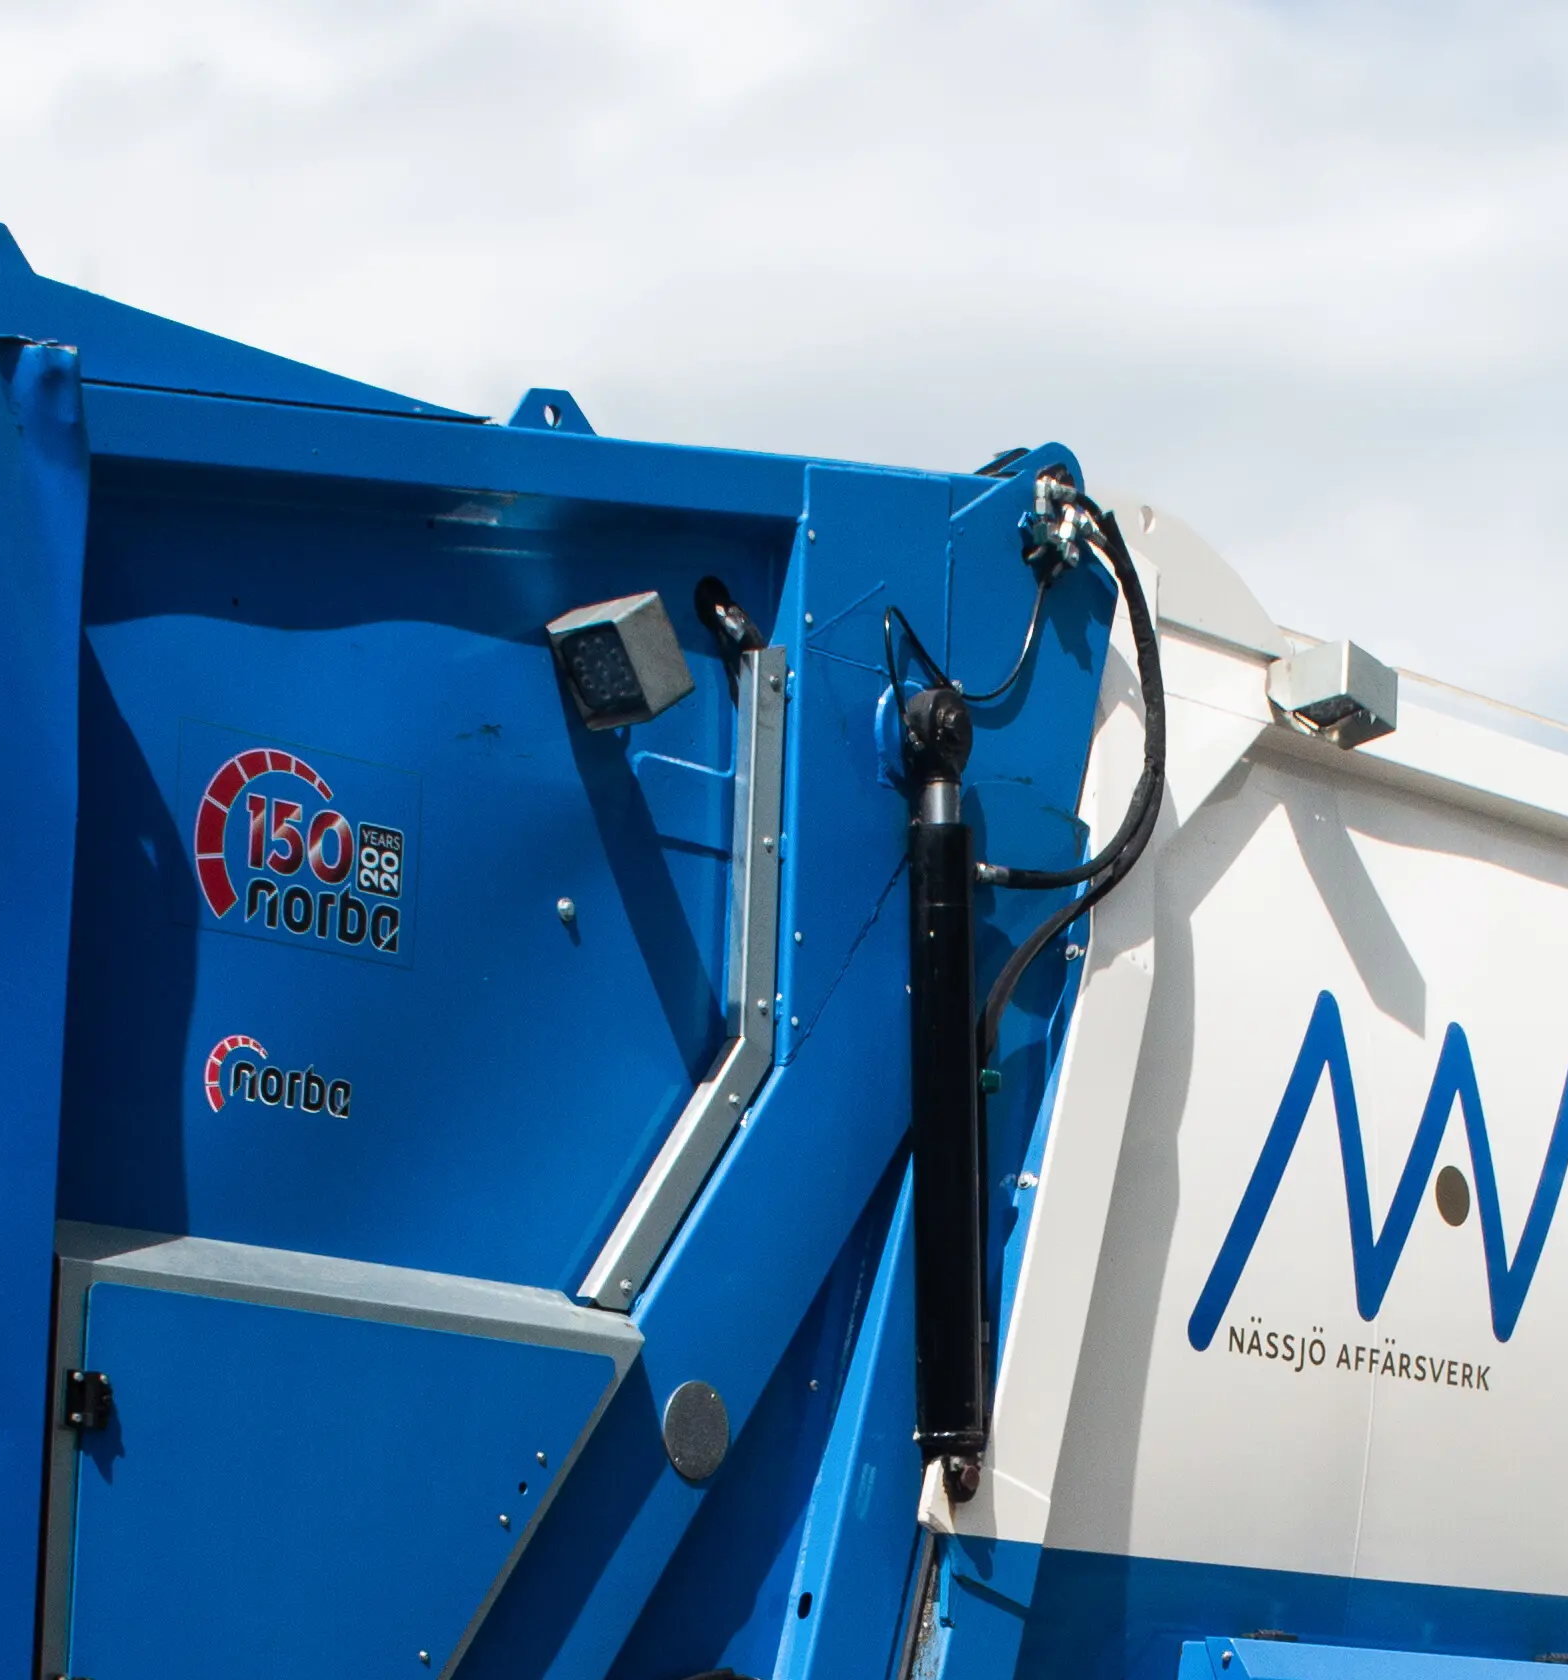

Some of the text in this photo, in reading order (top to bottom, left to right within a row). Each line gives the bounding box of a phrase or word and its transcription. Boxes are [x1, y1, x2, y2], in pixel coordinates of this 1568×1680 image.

[246, 793, 355, 885] 150
[362, 829, 401, 851] YEARS
[245, 878, 400, 954] norba
[230, 1062, 352, 1119] norba
[1228, 1316, 1491, 1391] NÄSSJÖ AFFÄRSVERK
